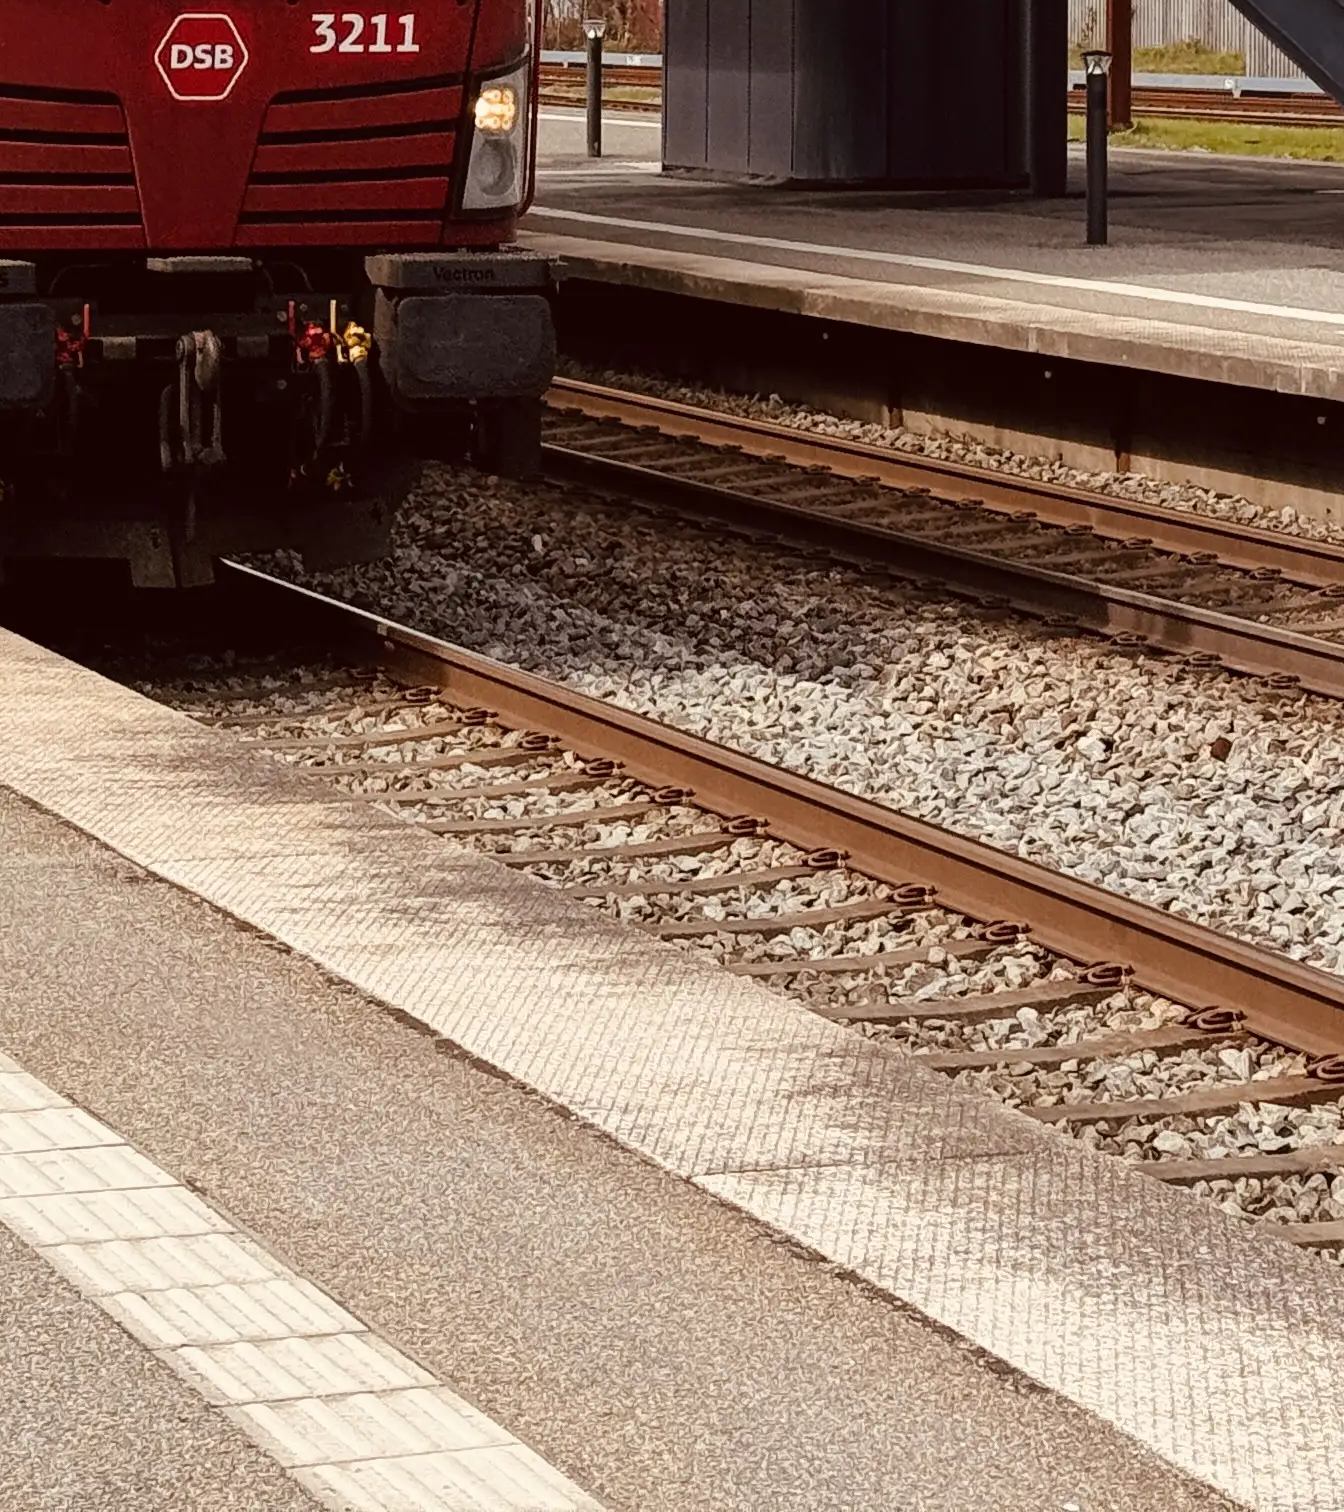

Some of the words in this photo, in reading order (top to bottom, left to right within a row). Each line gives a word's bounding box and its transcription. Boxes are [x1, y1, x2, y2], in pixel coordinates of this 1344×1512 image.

[309, 13, 420, 53] 3211
[170, 44, 234, 69] DSB
[432, 267, 495, 282] Vectron
